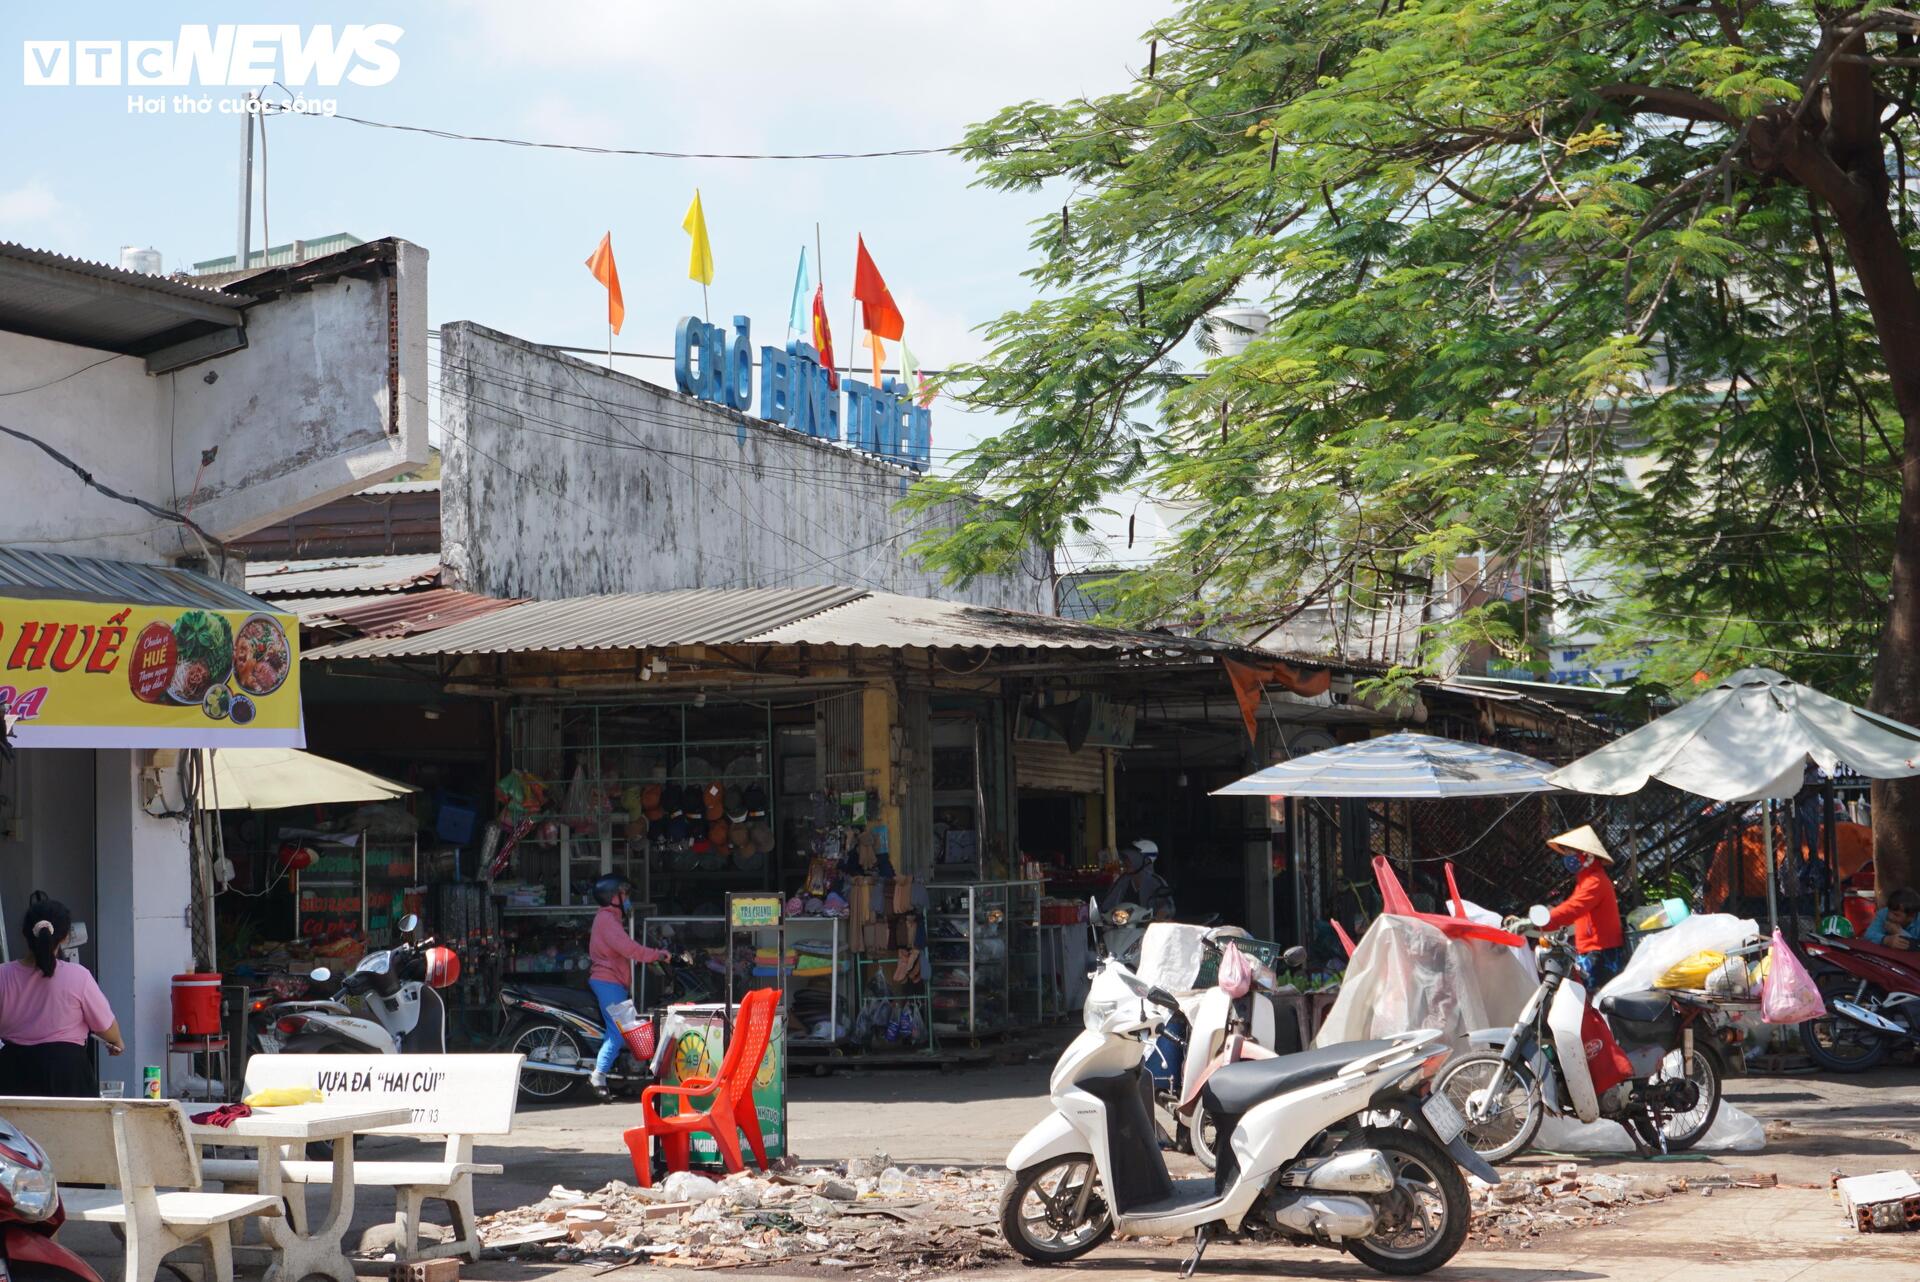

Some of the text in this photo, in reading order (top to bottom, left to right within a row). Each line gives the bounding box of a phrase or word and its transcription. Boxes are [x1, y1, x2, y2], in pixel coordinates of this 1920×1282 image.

[7, 607, 132, 674] HUẾ
[318, 1071, 347, 1096] VỰA
[351, 1066, 372, 1092] ĐÁ
